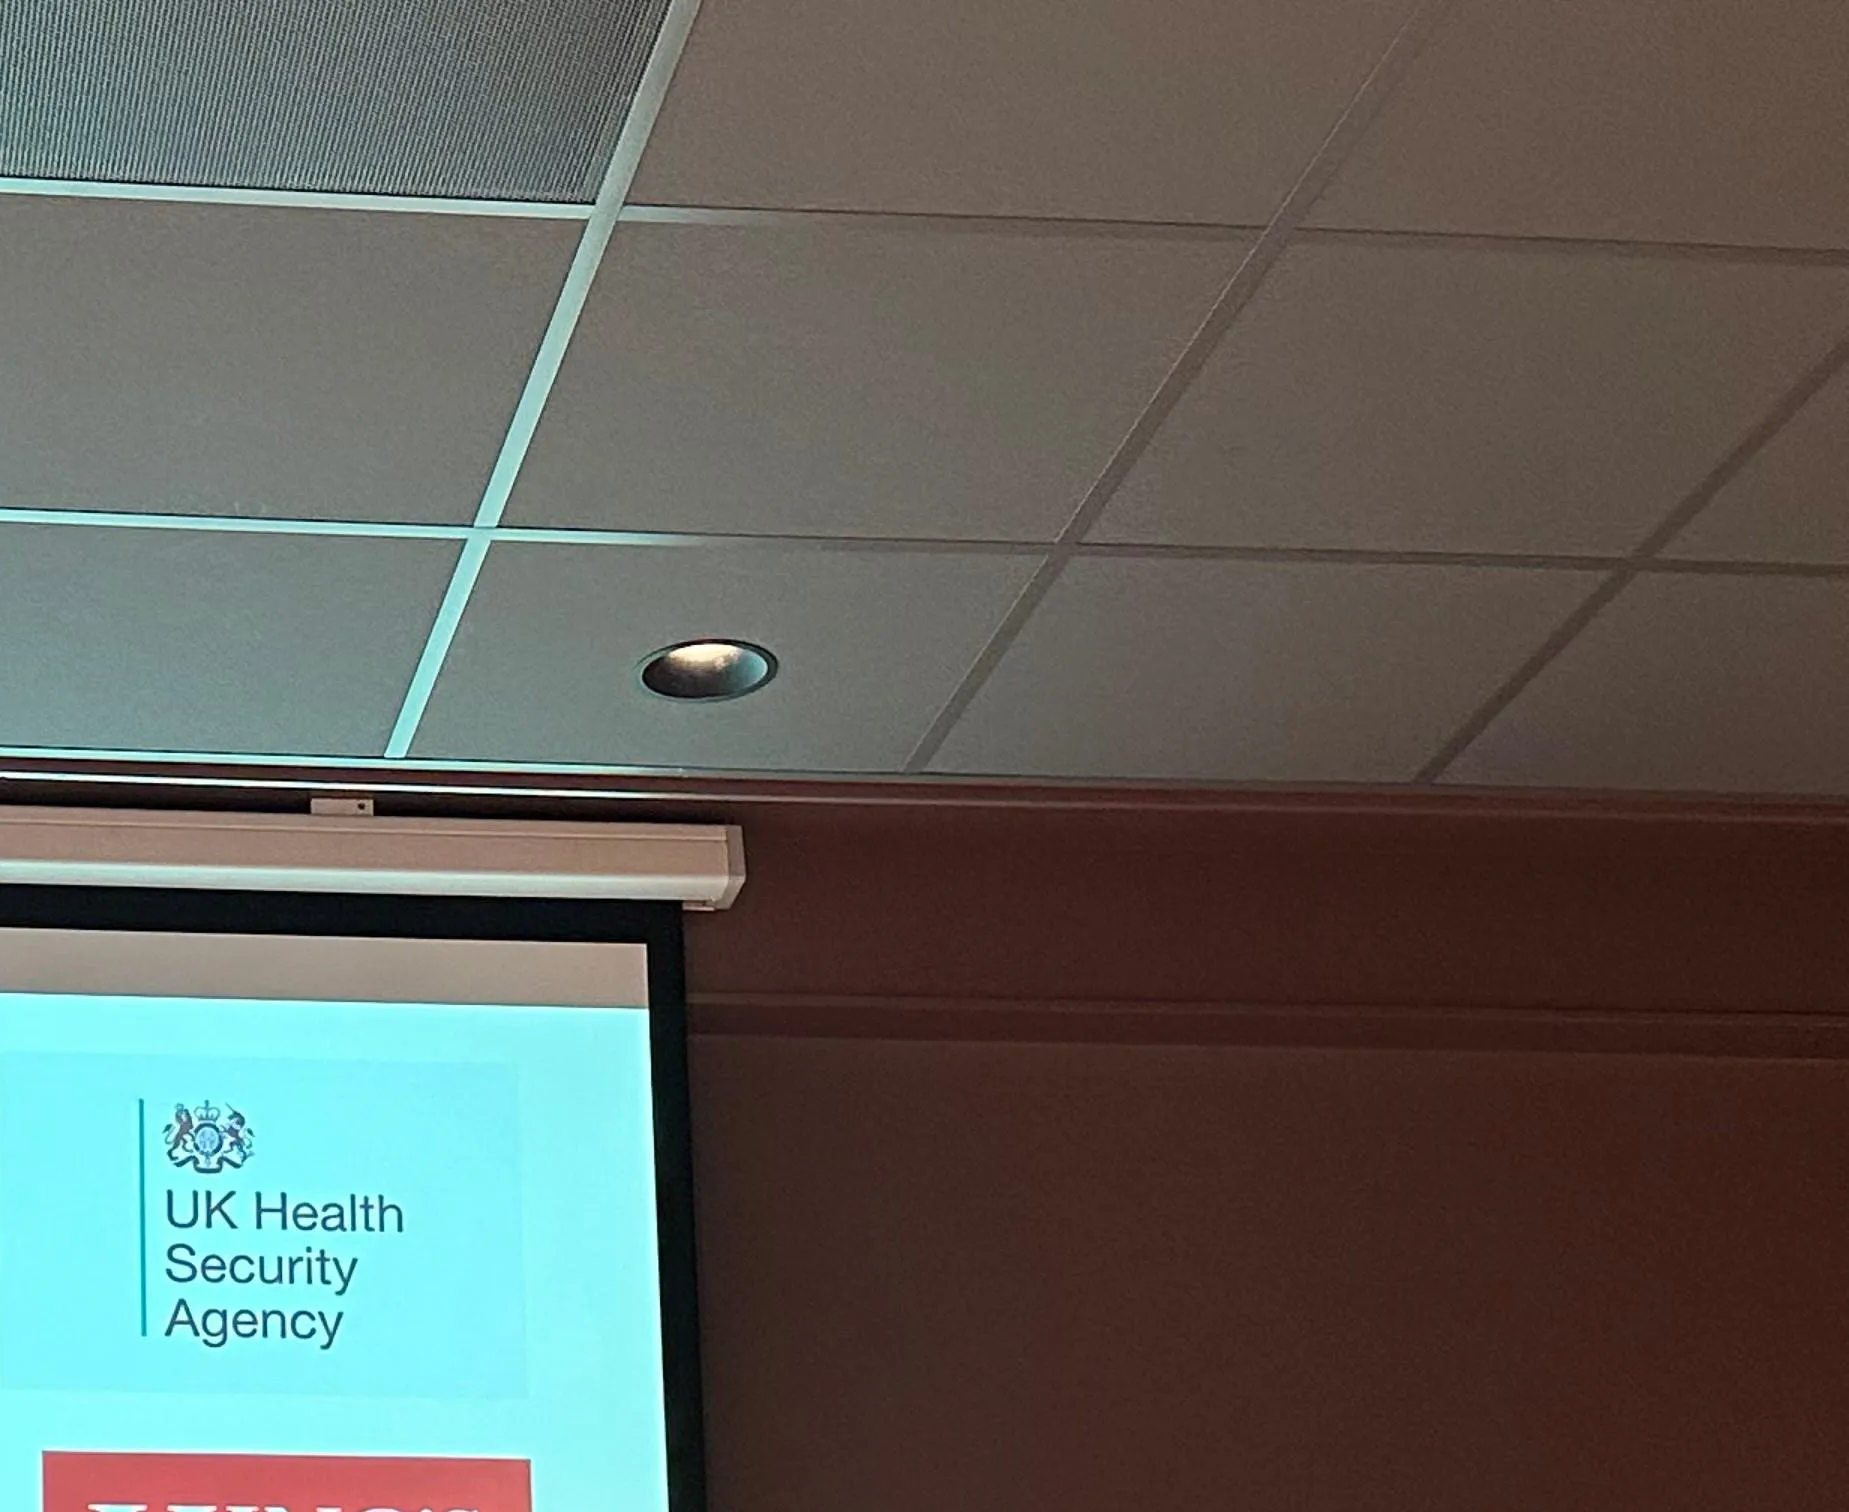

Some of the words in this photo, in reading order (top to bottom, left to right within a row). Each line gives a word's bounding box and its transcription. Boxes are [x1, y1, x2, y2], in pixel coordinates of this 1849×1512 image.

[167, 1189, 238, 1229] UK
[255, 1191, 403, 1232] Health
[166, 1244, 358, 1296] Security
[165, 1299, 343, 1350] Agency
